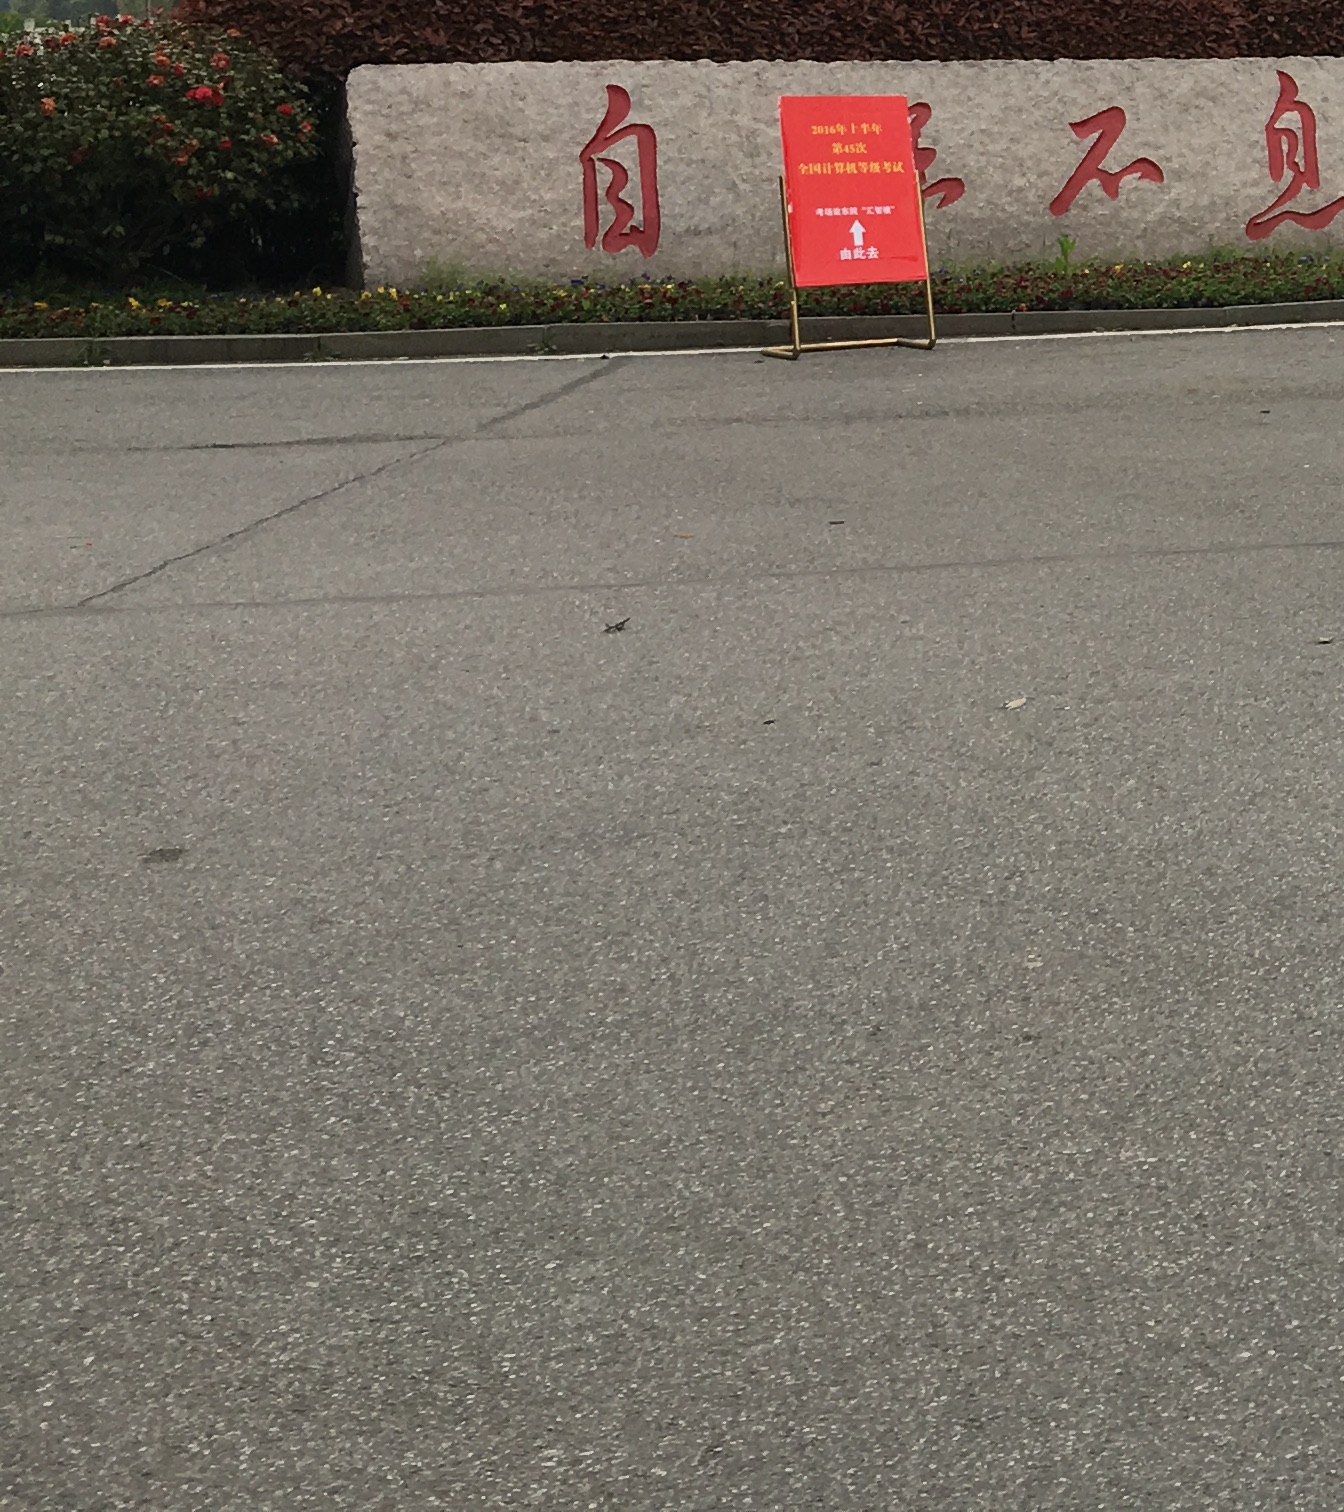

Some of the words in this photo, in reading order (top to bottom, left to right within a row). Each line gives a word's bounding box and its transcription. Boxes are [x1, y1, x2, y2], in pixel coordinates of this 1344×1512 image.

[832, 142, 868, 155] 第45次
[799, 162, 905, 175] 全国计算机等级考试
[840, 246, 879, 261] 由此去
